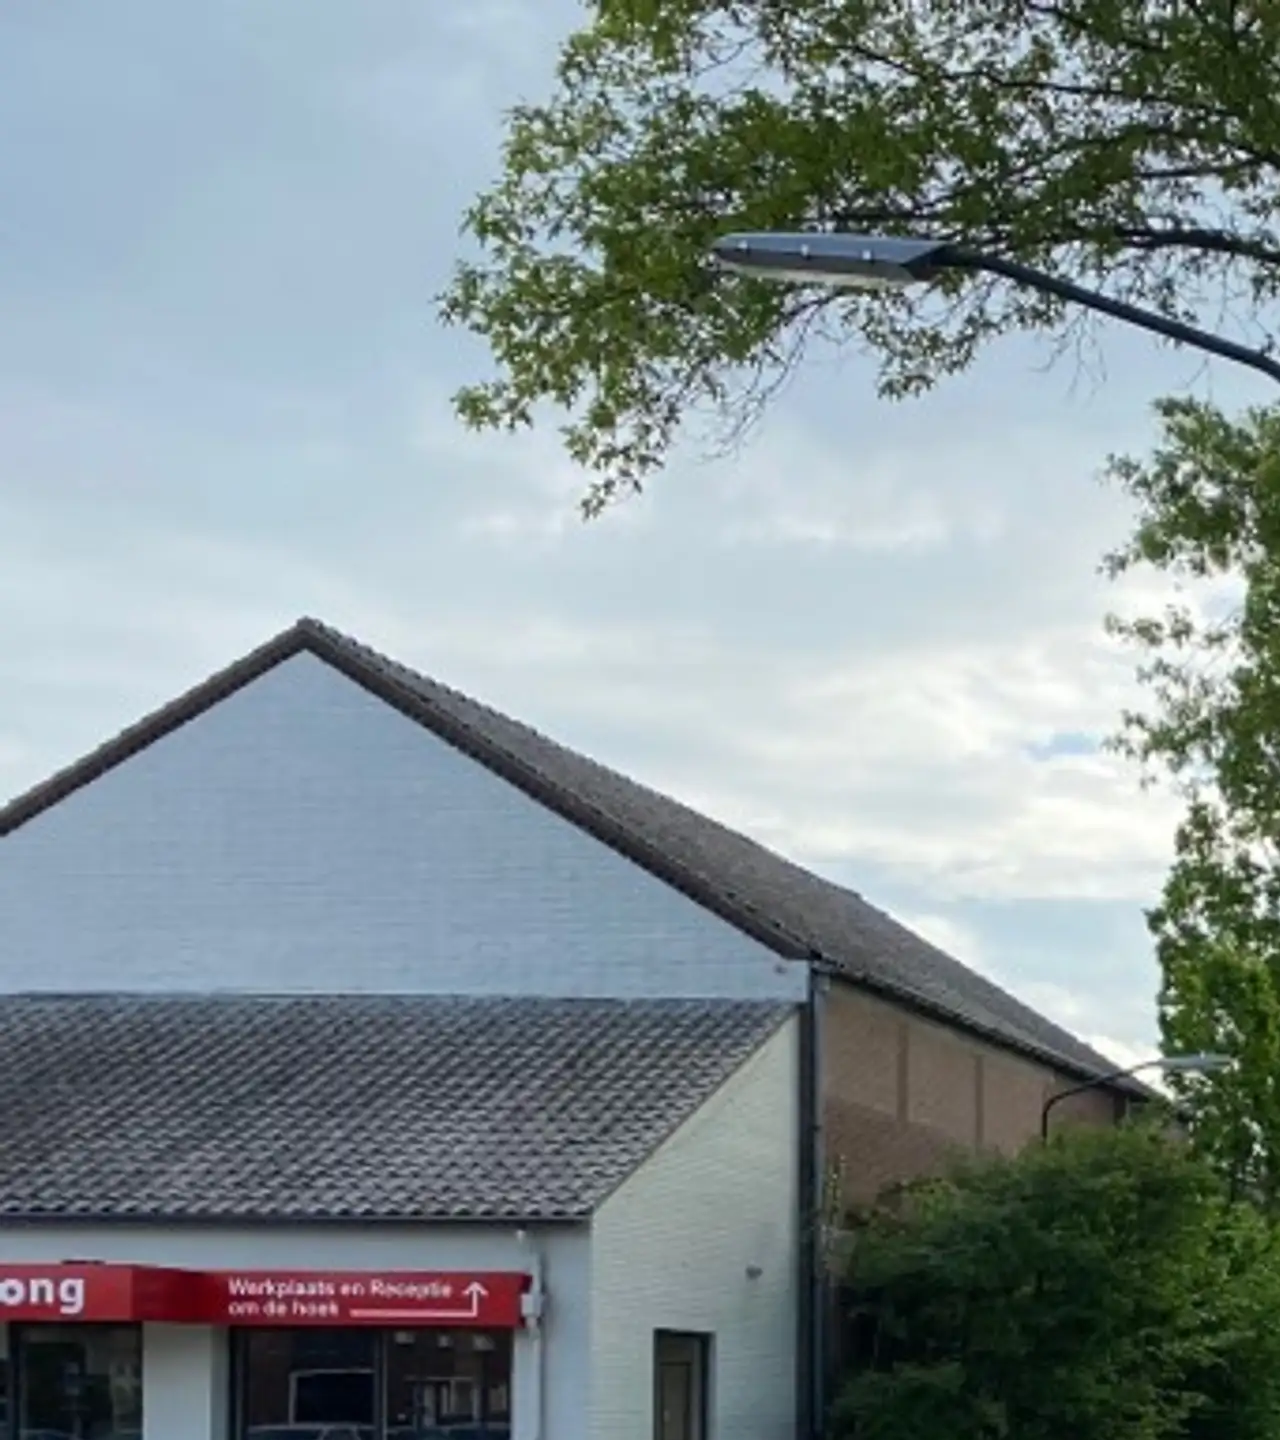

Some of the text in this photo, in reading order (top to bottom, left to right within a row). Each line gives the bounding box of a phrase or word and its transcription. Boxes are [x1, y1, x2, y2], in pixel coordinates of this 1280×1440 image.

[228, 1277, 452, 1299] Werkplaats en Receptie
[228, 1299, 339, 1316] om de hoek
